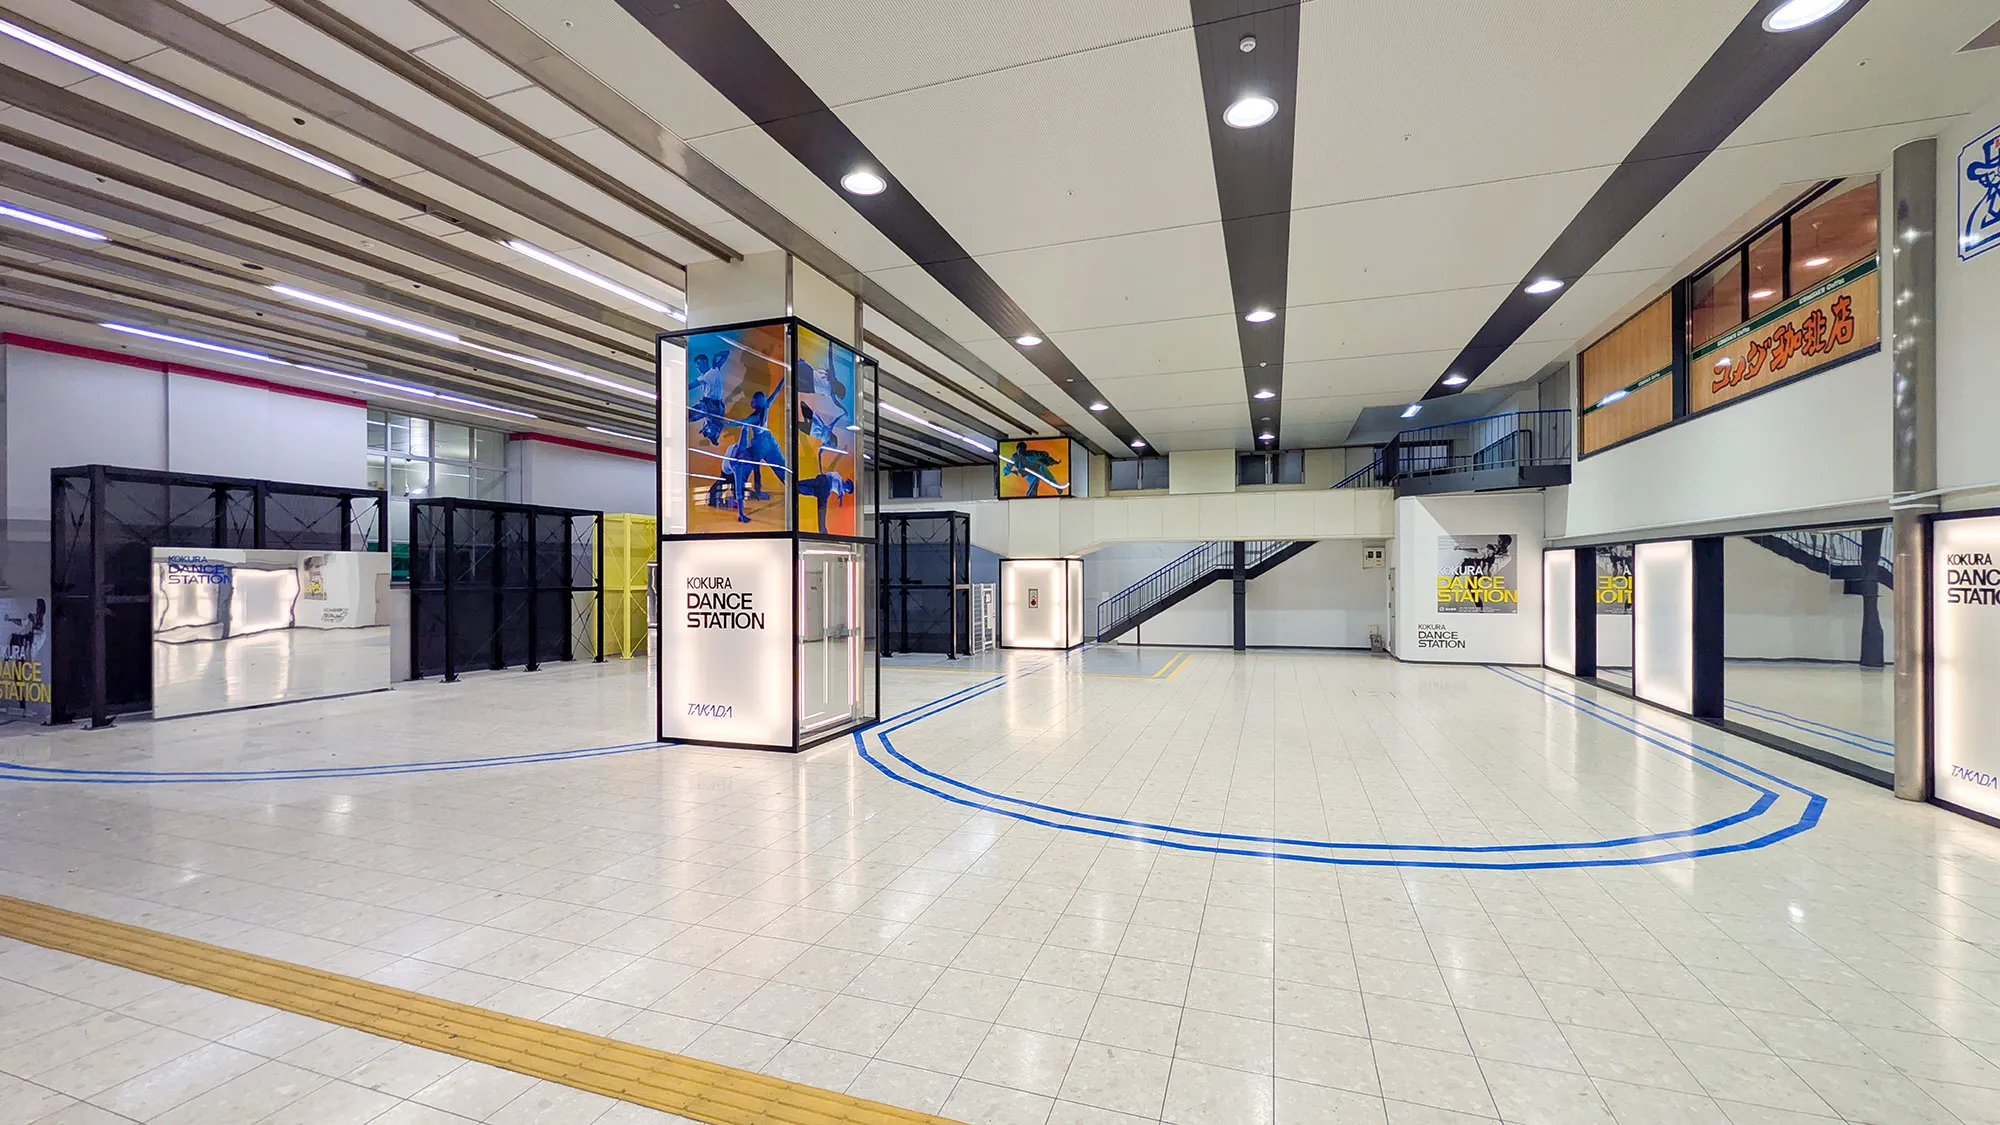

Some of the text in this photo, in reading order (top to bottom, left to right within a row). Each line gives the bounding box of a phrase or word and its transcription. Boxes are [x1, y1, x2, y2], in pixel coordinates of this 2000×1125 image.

[1712, 295, 1854, 393] コメダ珈琲店
[168, 555, 209, 564] KOKURA
[1947, 553, 1993, 566] KOKURA
[168, 564, 225, 575] DANCE
[1437, 565, 1484, 576] KOKURA
[168, 574, 231, 585] STATION
[687, 576, 733, 589] KOKURA
[1437, 576, 1505, 589] DANCE
[687, 593, 753, 610] DANCE
[1437, 589, 1518, 603] STATION
[687, 611, 765, 629] STATION
[1417, 623, 1447, 631] KOKURA
[1418, 631, 1459, 640] DANCE
[1418, 639, 1466, 649] STATION
[688, 703, 733, 718] TAKADA
[1951, 764, 1998, 790] TAKADA
